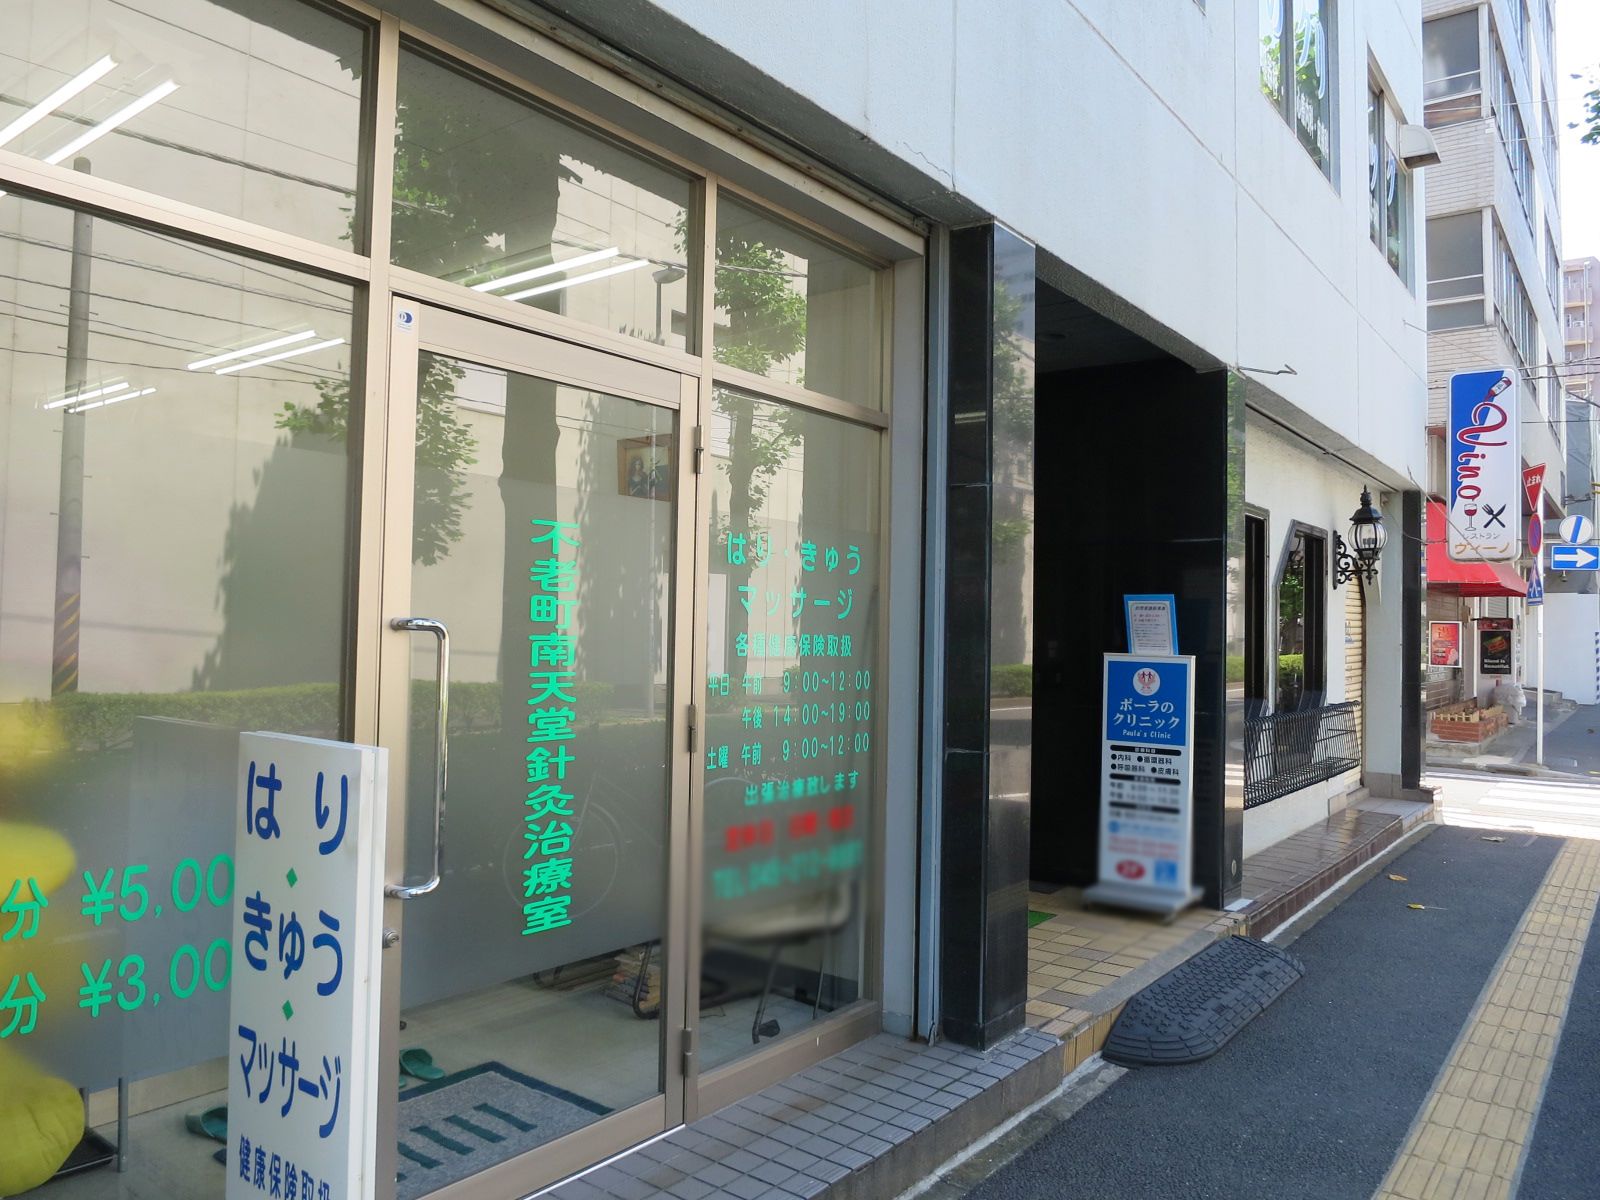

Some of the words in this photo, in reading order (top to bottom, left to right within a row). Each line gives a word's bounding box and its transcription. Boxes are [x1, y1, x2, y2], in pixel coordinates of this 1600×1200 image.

[1456, 401, 1508, 502] Vino
[738, 585, 854, 620] マッサージ
[735, 631, 852, 657] 各種健康保険取扱
[708, 672, 730, 697] 平日
[742, 671, 763, 696] 午前
[521, 518, 582, 936] 不老町南天堂針灸治療室
[741, 705, 763, 729] 午後
[1113, 713, 1180, 730] クリニック
[1150, 731, 1172, 739] Clinic
[706, 744, 729, 770] 土曜
[741, 742, 762, 766] 午前
[246, 760, 348, 856] はり
[1, 877, 48, 942] 分
[243, 890, 343, 997] きゅう
[0, 972, 46, 1038] 分
[238, 1025, 342, 1139] マッサージ
